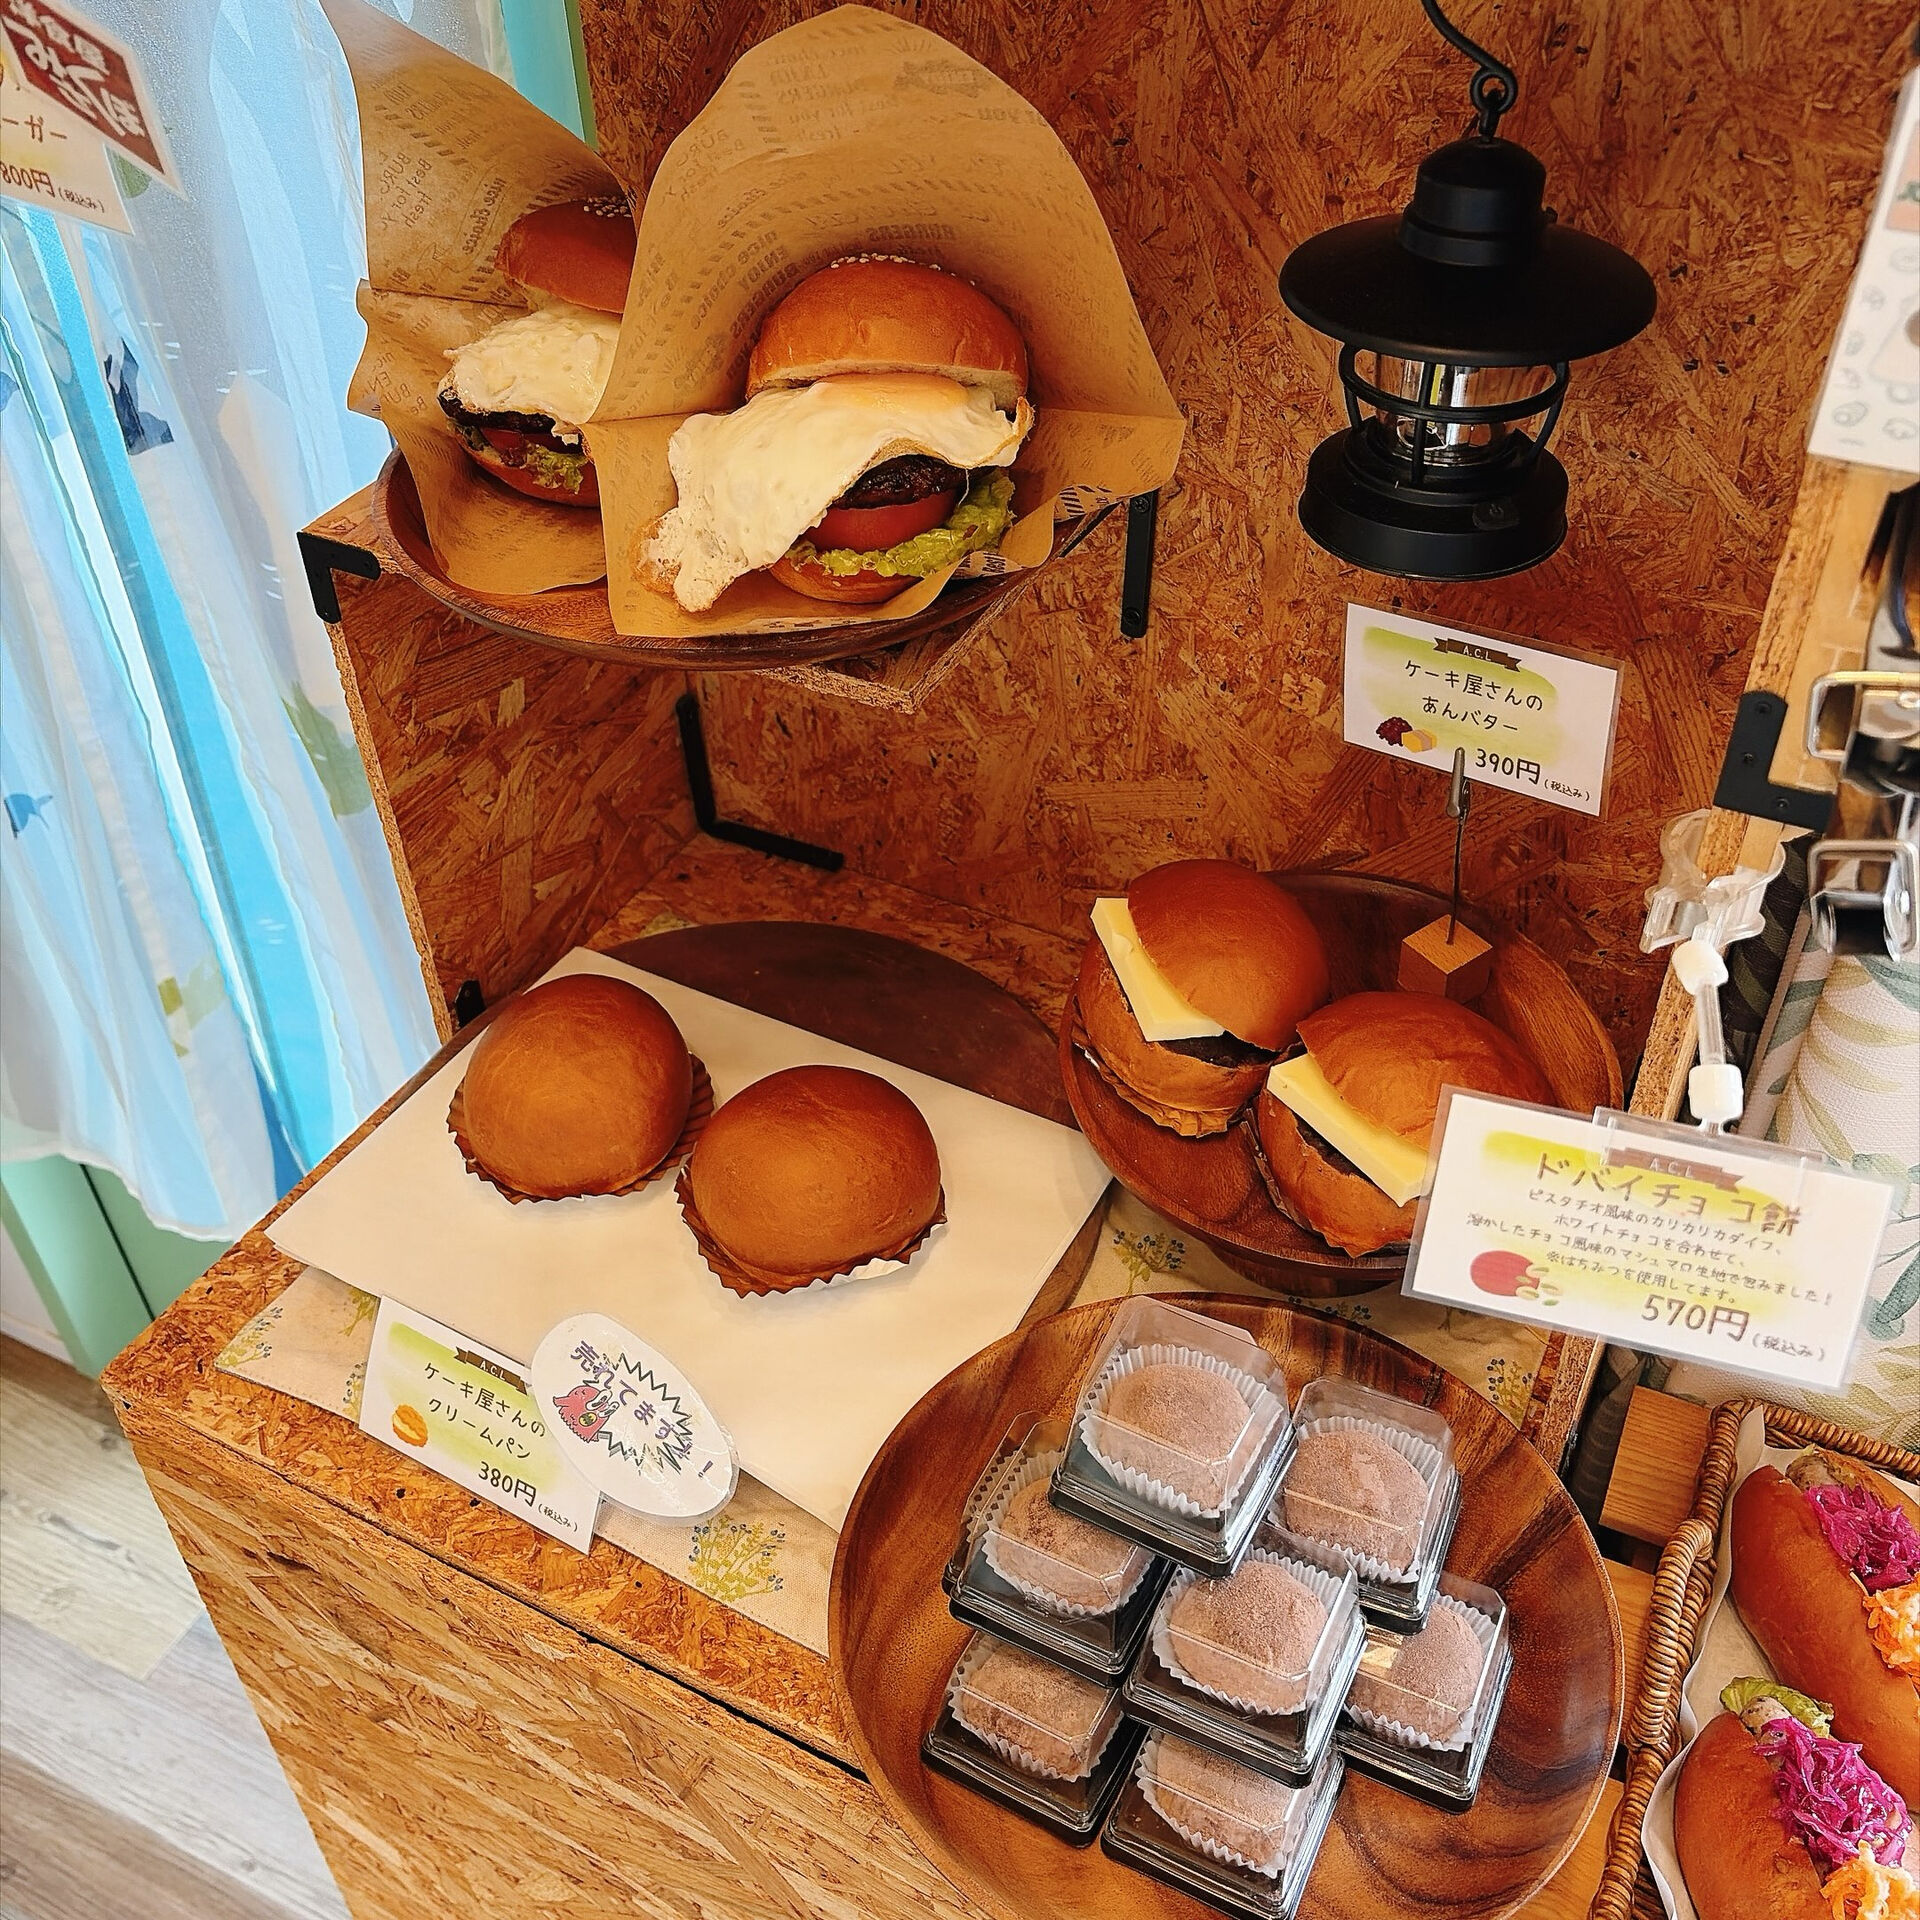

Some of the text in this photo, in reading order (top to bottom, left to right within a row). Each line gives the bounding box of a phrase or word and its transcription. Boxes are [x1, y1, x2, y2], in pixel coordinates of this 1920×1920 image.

[0, 114, 67, 143] ーガー
[1405, 660, 1543, 711] ケーキ屋さんの
[1422, 695, 1518, 732] あんバター
[1475, 748, 1591, 802] 390円 (税込み)
[1536, 1152, 1802, 1236] ドバイチョコ餅
[1641, 1294, 1825, 1361] 570円 (税込み)
[424, 1362, 546, 1438] ケーキ屋さんの
[429, 1398, 531, 1460] クリームパン
[479, 1461, 537, 1508] 380円
